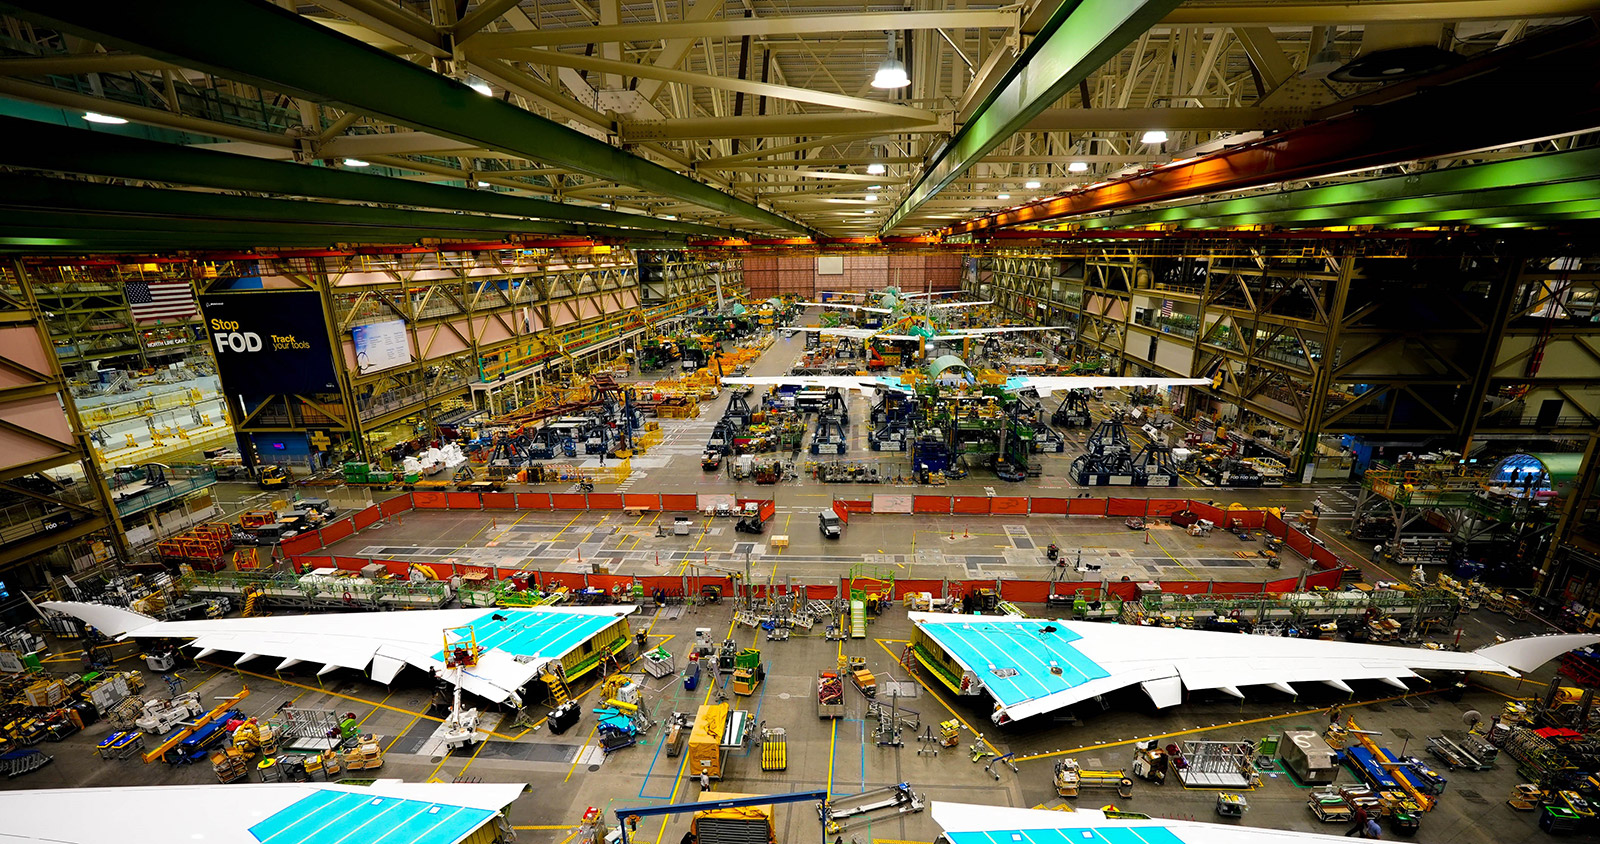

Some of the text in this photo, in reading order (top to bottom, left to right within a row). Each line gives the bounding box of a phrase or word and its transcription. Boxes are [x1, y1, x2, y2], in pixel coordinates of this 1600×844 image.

[211, 318, 239, 332] Stop
[214, 333, 262, 353] FOD
[271, 334, 295, 342] Track
[273, 341, 310, 351] your tools
